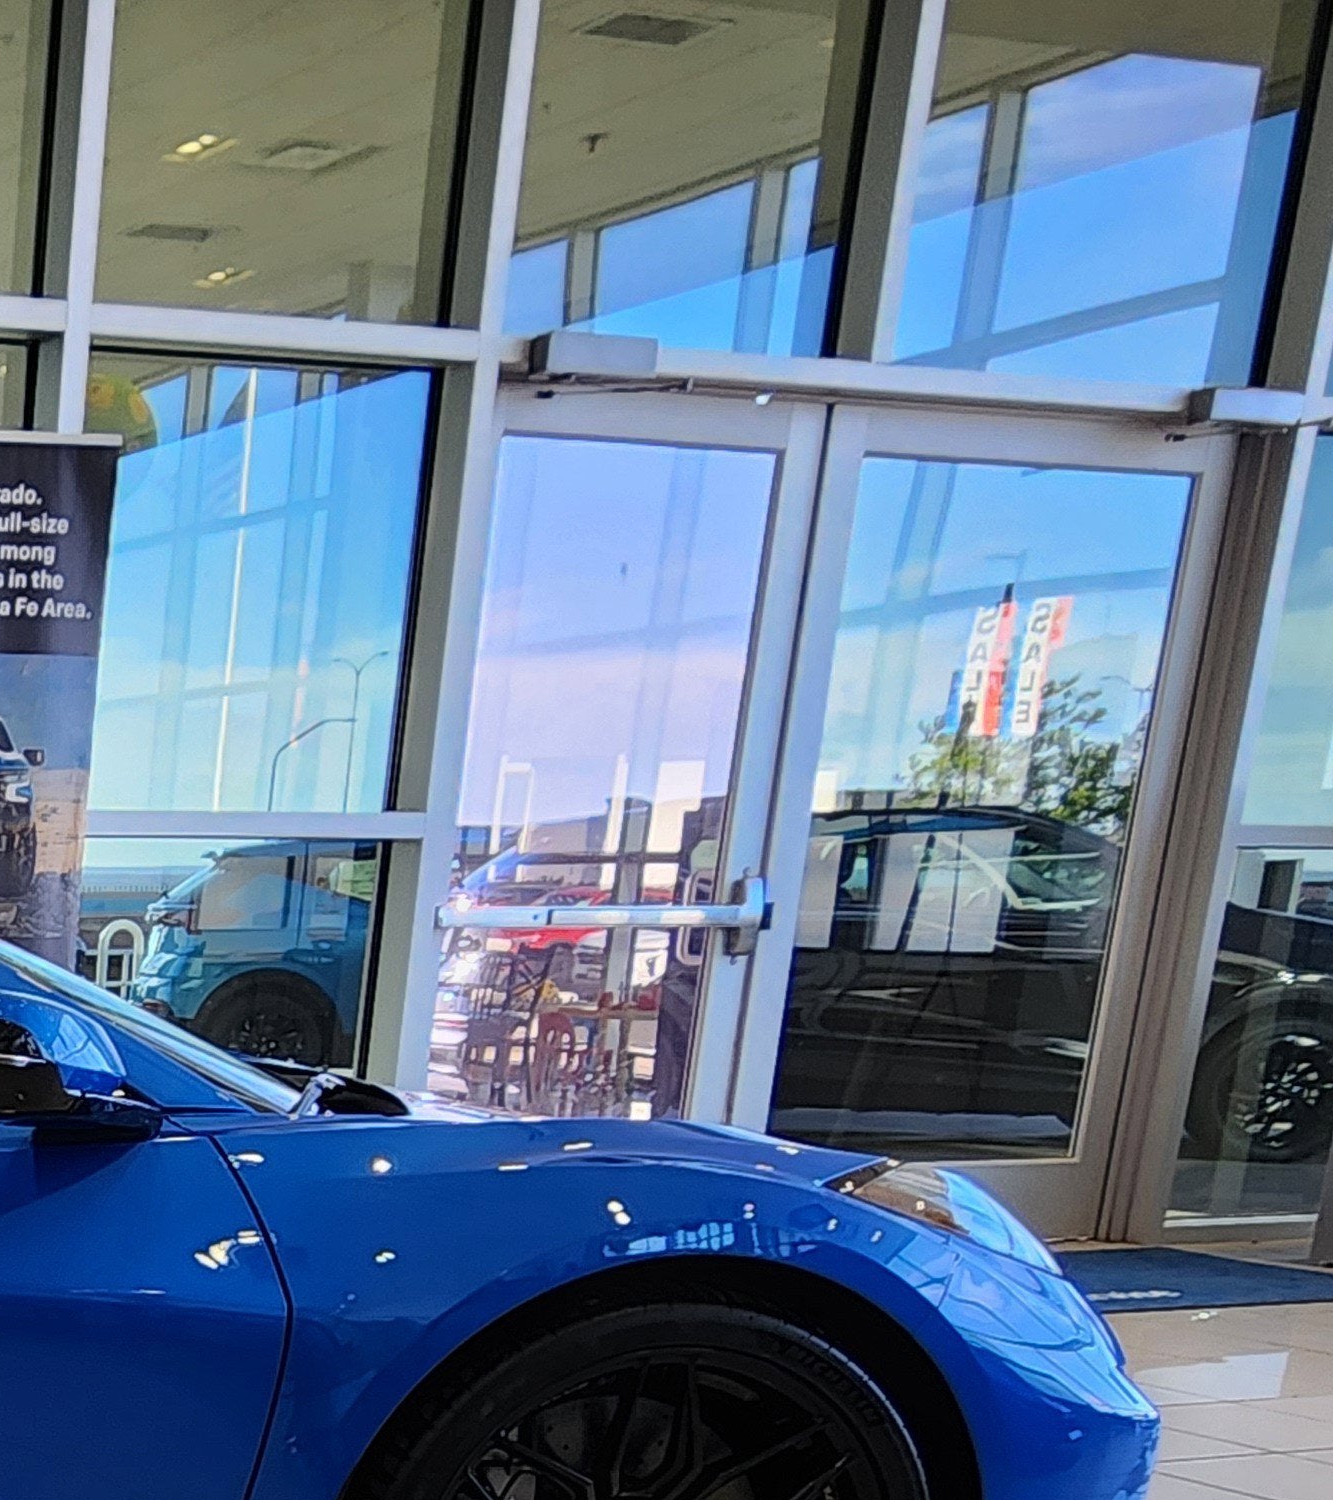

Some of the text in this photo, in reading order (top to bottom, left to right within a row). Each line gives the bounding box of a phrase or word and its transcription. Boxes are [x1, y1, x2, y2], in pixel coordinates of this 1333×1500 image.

[8, 568, 27, 588] in
[31, 570, 64, 589] the
[15, 597, 38, 616] Fe
[41, 598, 92, 619] Area.
